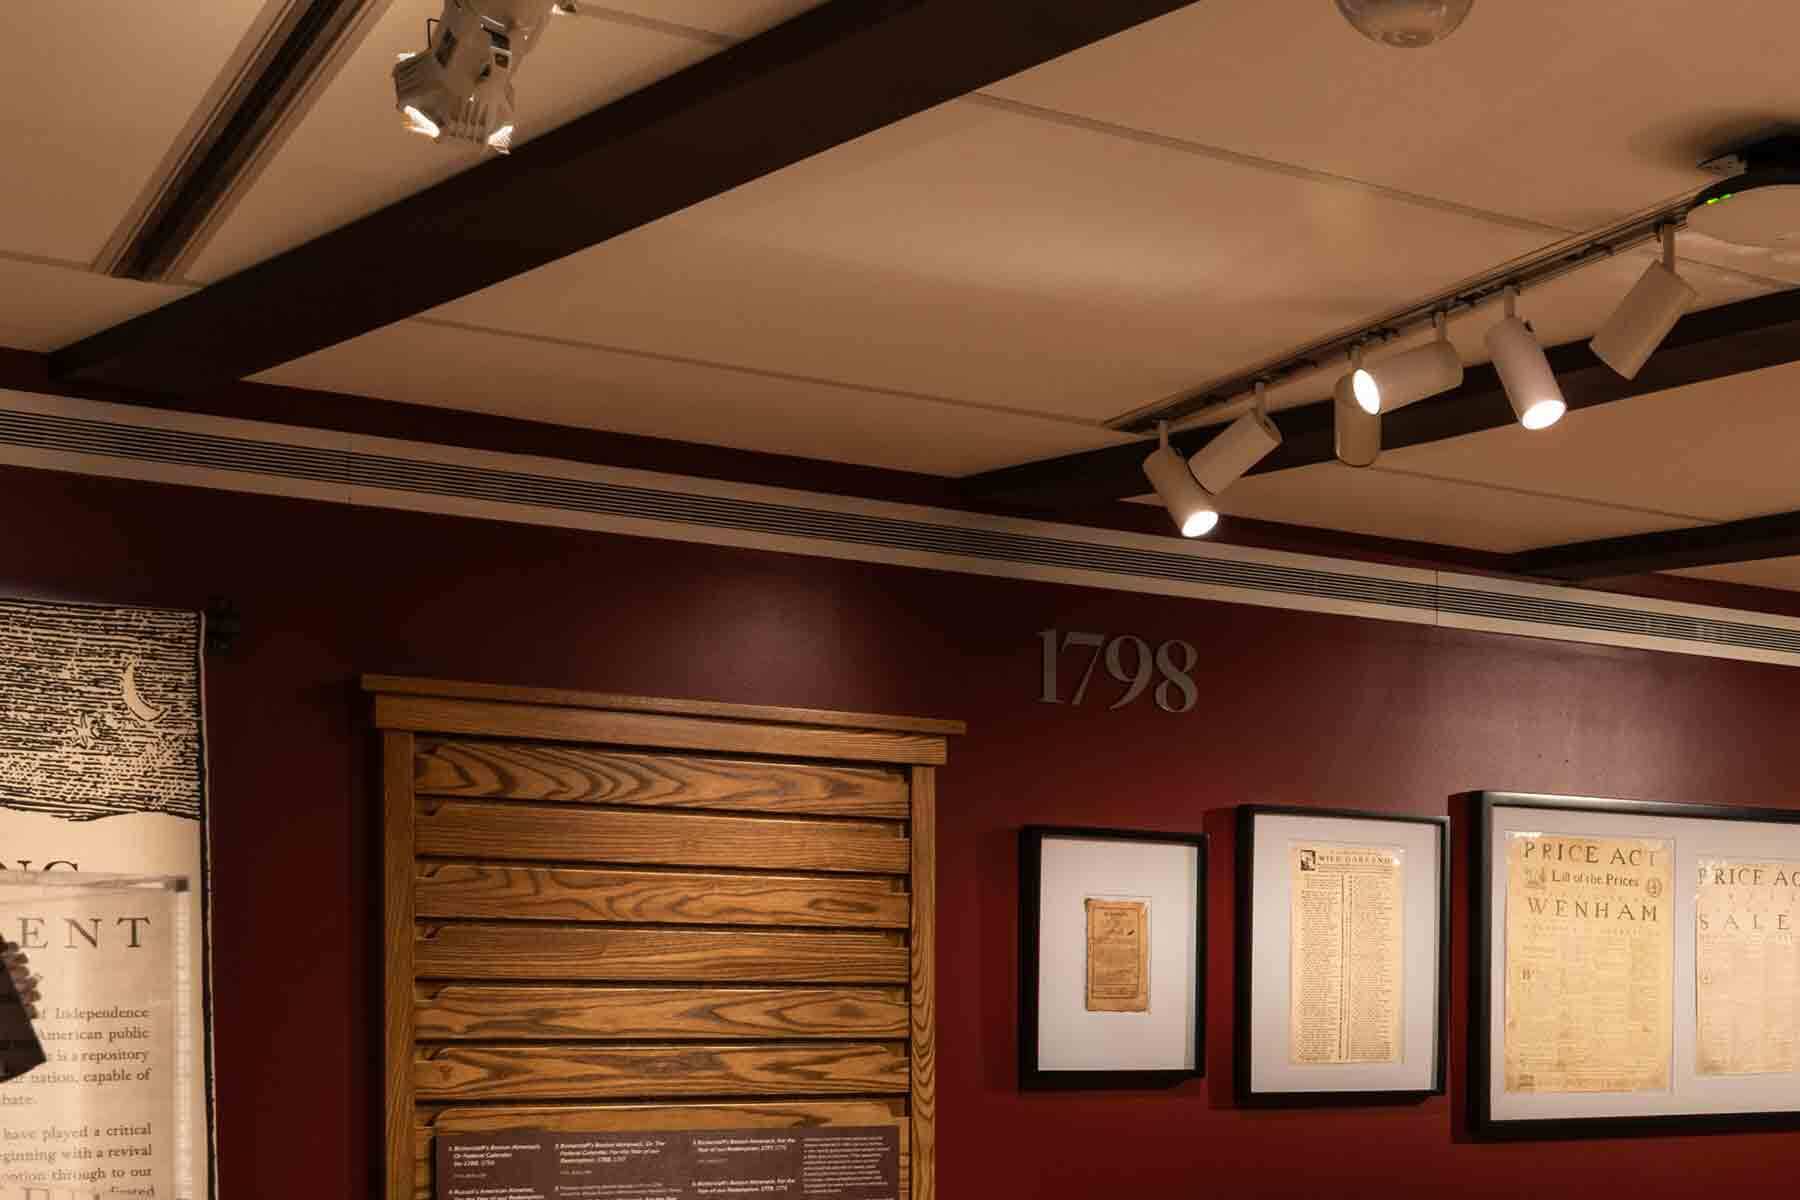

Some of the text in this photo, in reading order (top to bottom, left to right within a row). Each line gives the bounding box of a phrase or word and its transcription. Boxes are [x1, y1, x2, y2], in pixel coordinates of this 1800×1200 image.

[1034, 629, 1199, 713] 1798
[1523, 840, 1658, 867] PRICE ACT
[1697, 867, 1763, 886] PRICE
[1527, 897, 1658, 922] WENHAM
[55, 1006, 150, 1021] Independence
[108, 1026, 151, 1043] public
[81, 1049, 149, 1065] repository
[83, 1069, 132, 1086] capable
[136, 1067, 152, 1081] of
[3, 1127, 35, 1141] have
[41, 1125, 89, 1143] played
[106, 1121, 152, 1137] critical
[108, 1143, 152, 1158] revival
[52, 1166, 106, 1183] through
[111, 1166, 126, 1178] to
[130, 1166, 152, 1177] our
